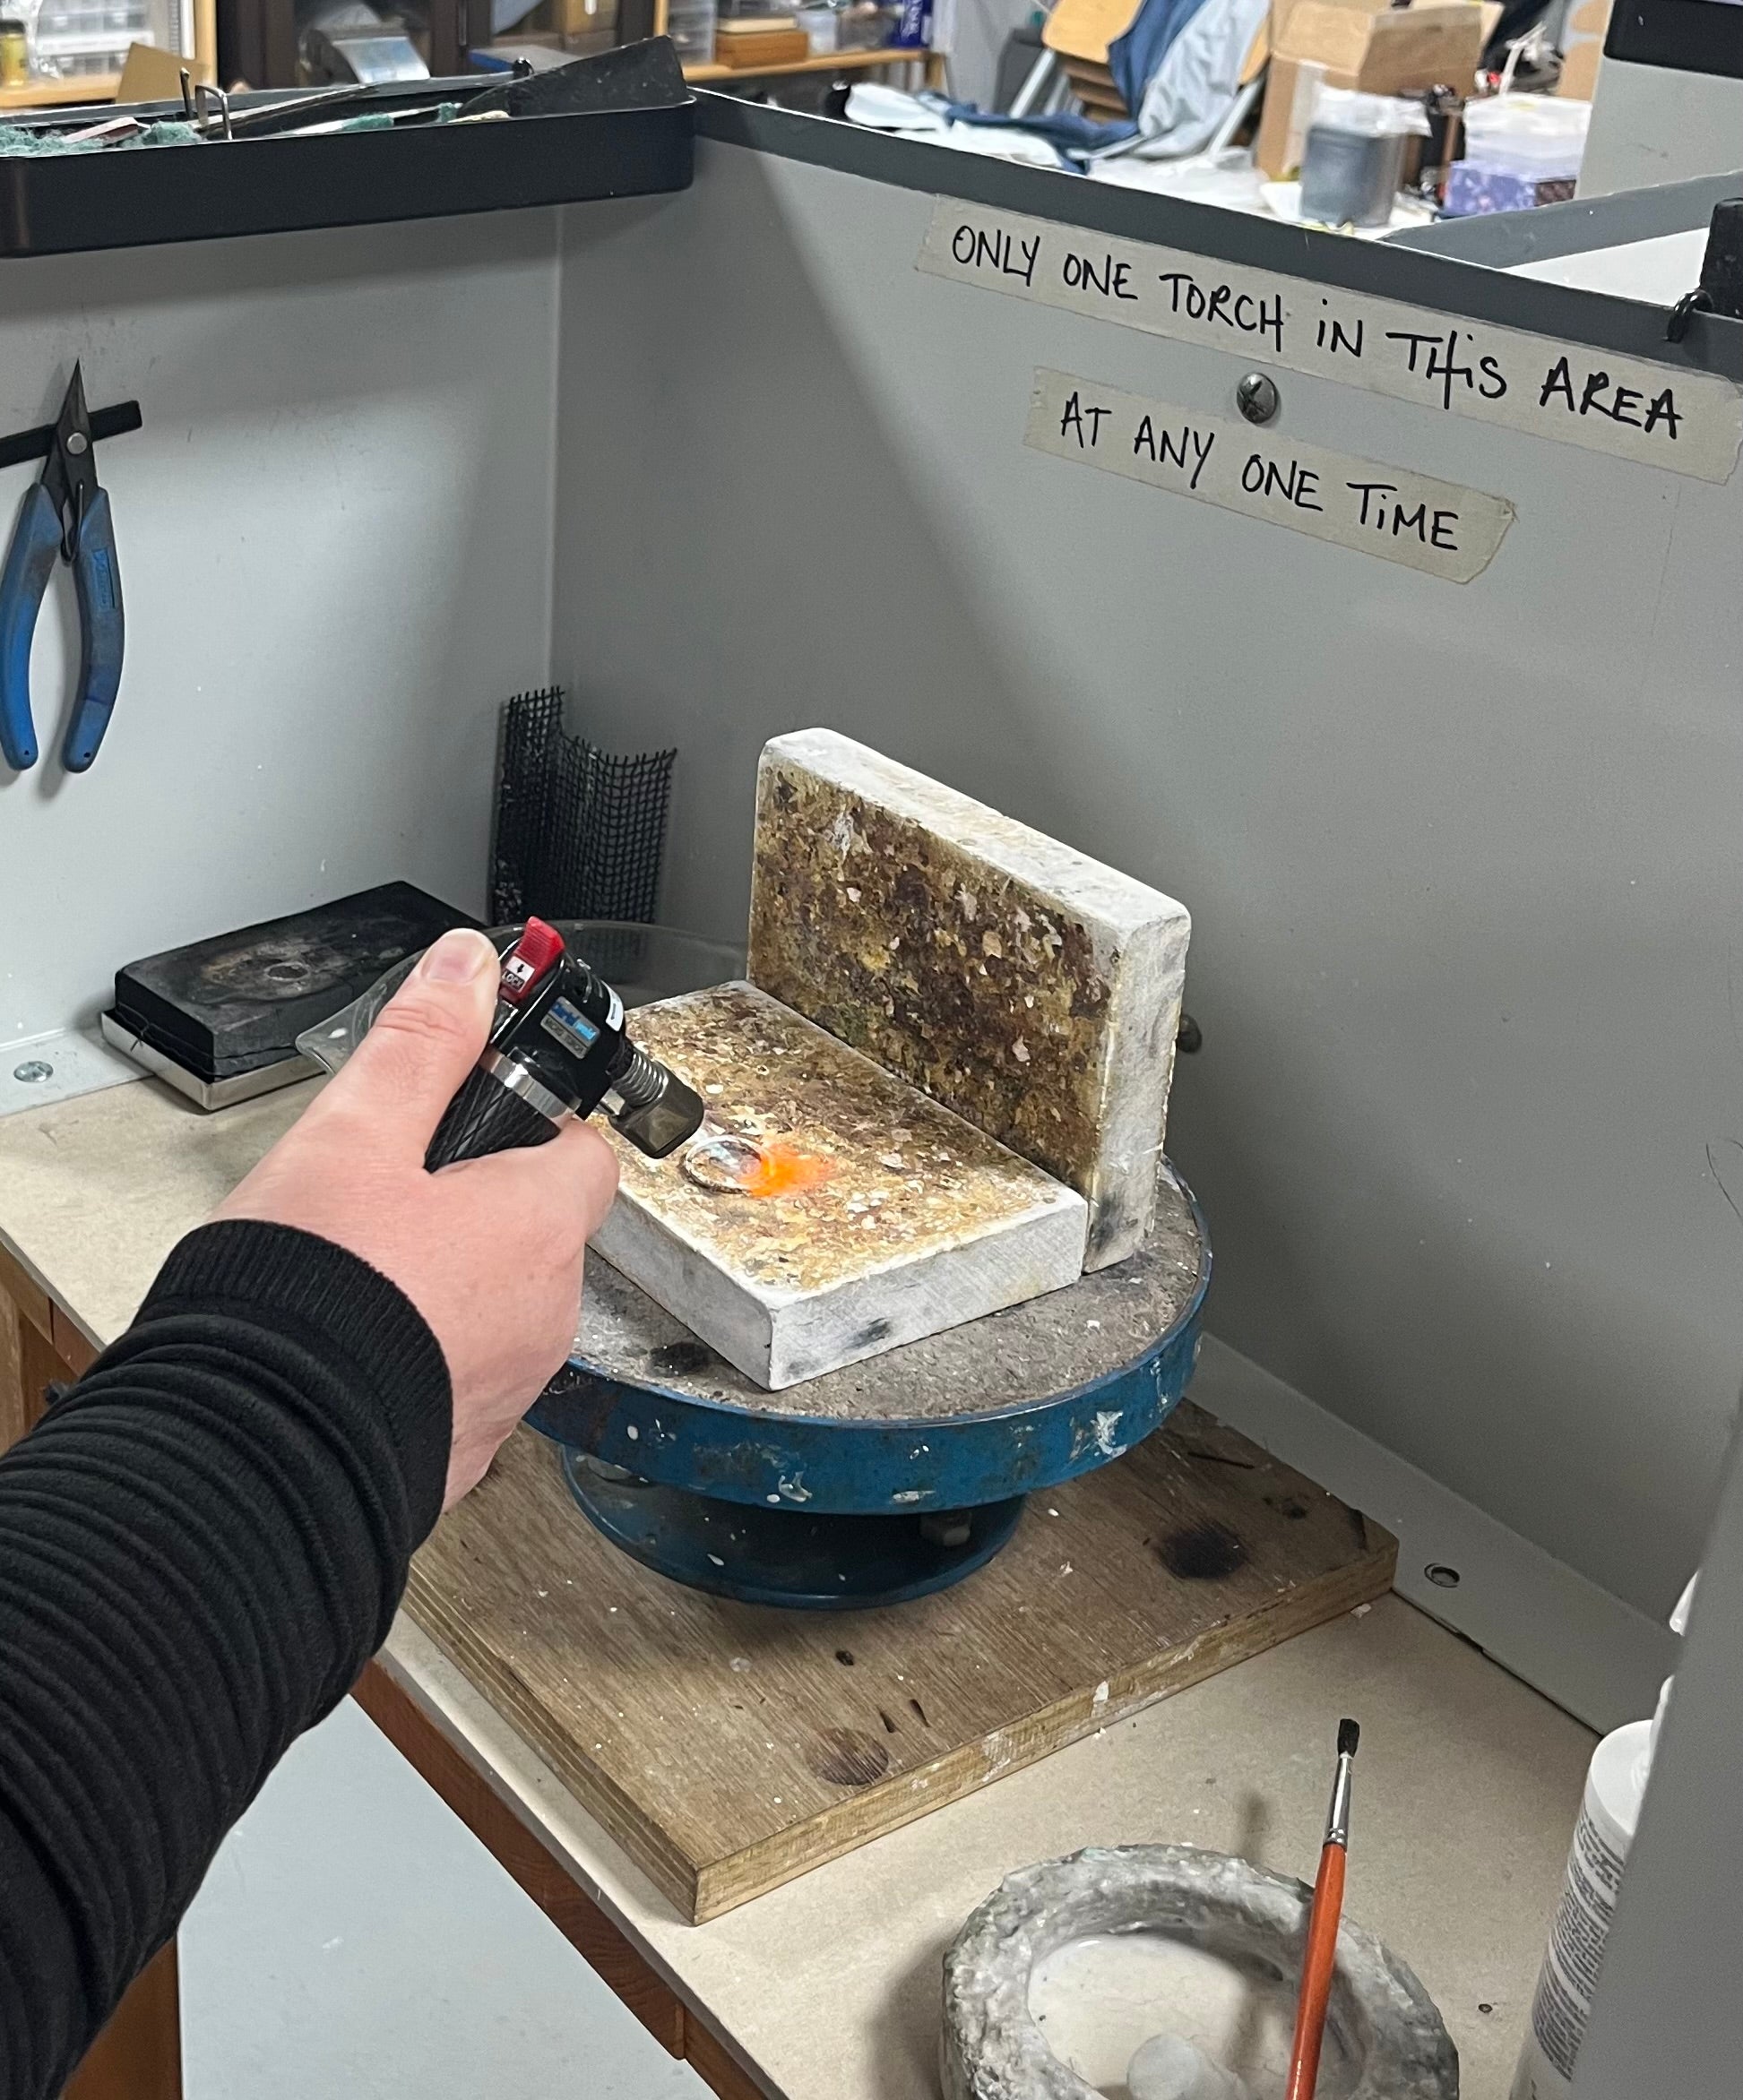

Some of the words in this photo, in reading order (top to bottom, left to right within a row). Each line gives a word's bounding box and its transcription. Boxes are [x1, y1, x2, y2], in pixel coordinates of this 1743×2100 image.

[953, 226, 1040, 287] ONLY
[1064, 254, 1138, 300] ONE
[1159, 274, 1284, 353] TORCH
[1540, 357, 1684, 440] AREA
[1061, 392, 1112, 449] AT
[1135, 416, 1215, 490] ANY
[1242, 454, 1324, 512] ONE
[502, 969, 524, 986] LOCK
